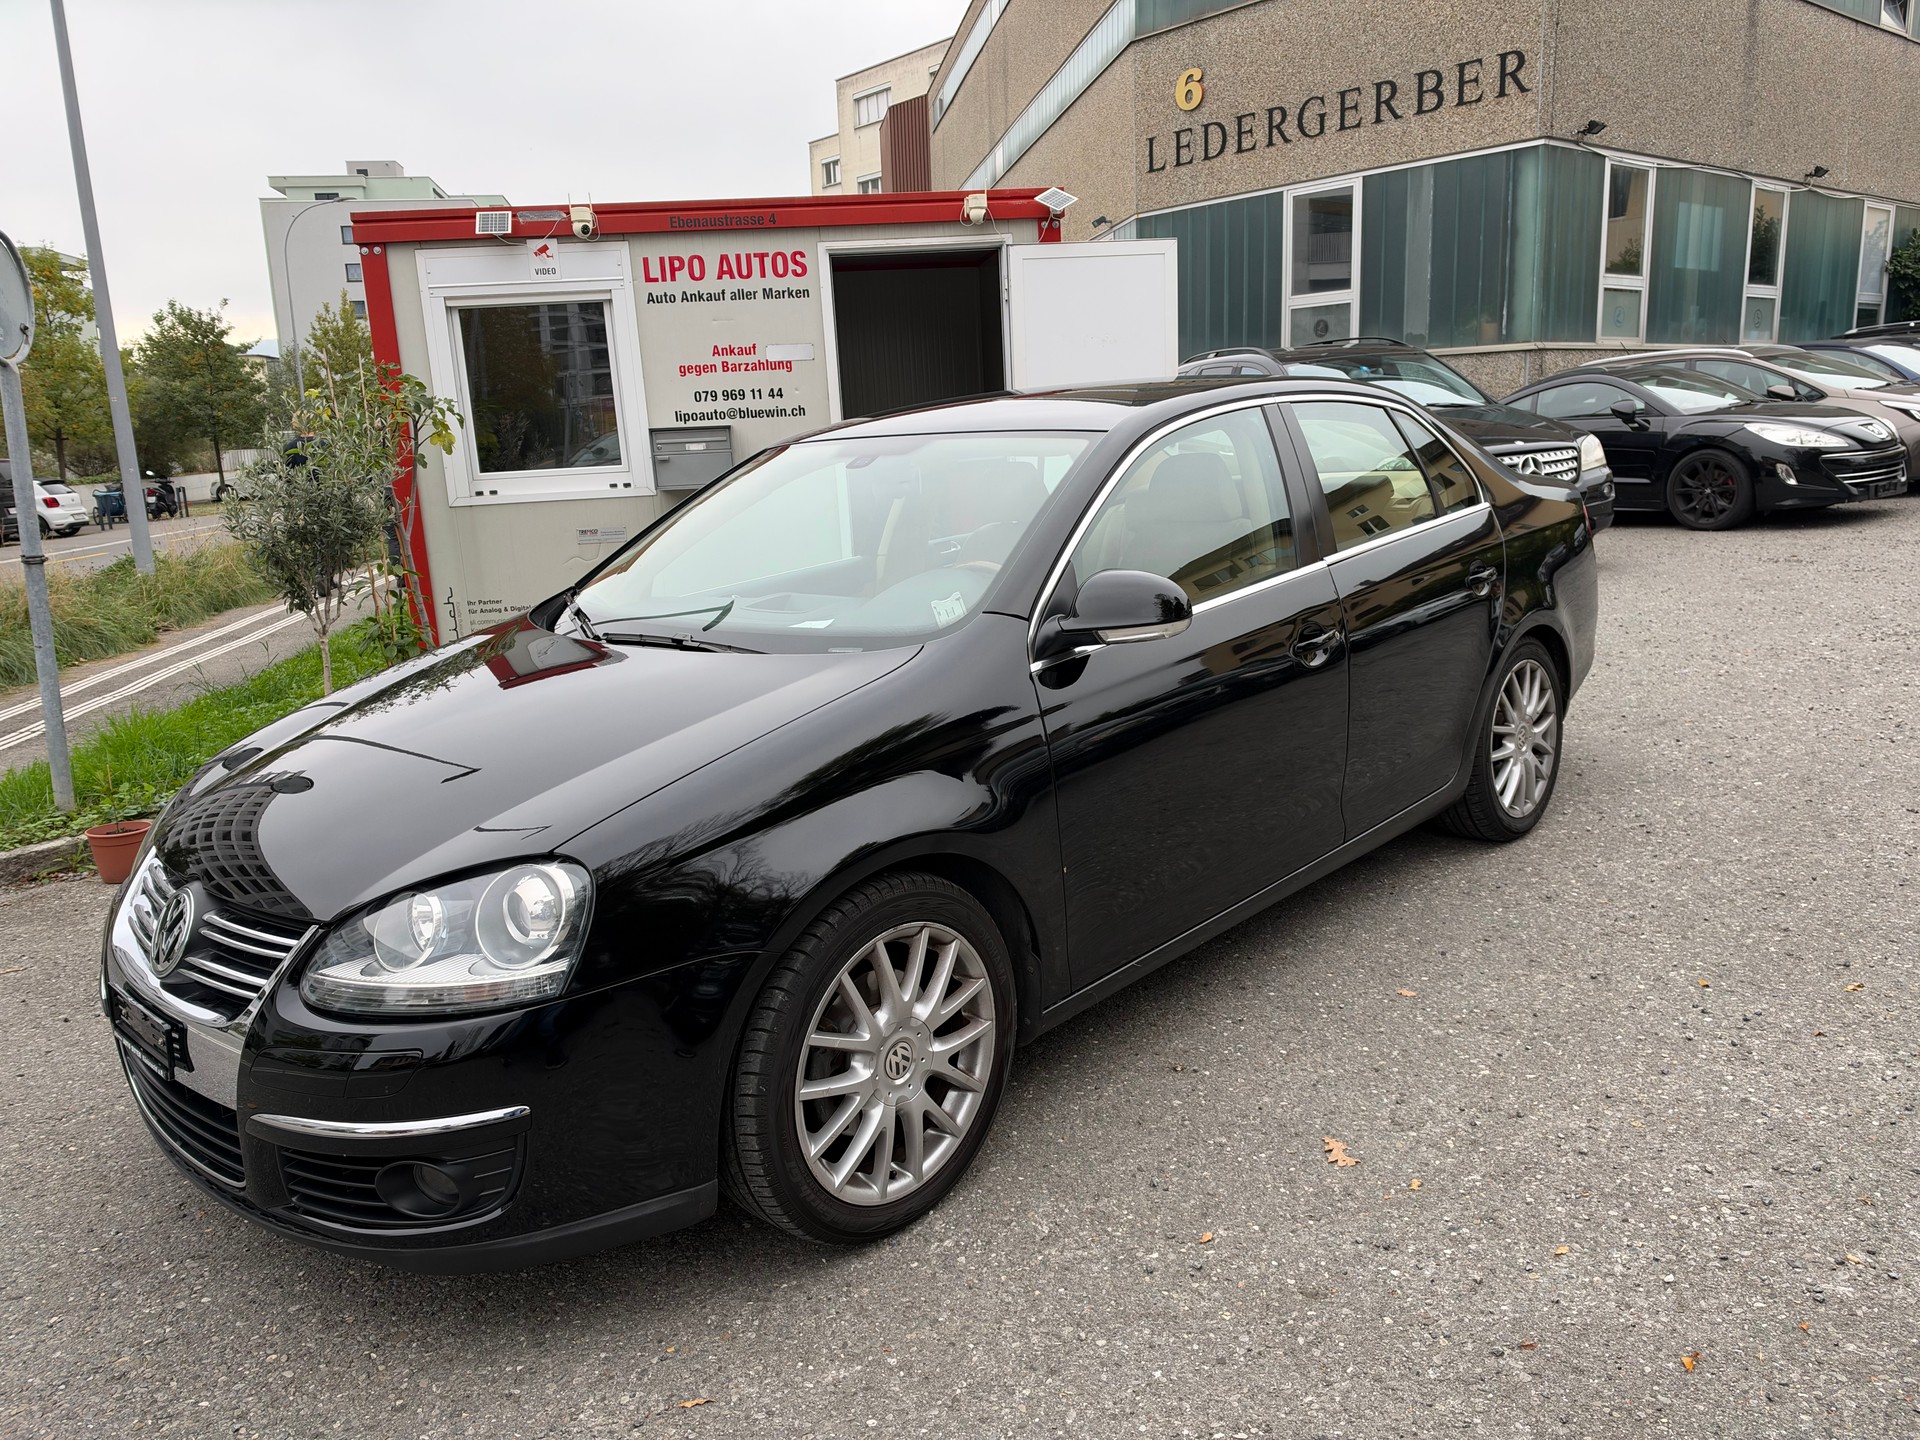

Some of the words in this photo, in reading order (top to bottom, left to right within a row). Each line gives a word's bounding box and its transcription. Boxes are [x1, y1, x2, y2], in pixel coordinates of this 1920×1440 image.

[1175, 67, 1204, 111] 6
[1146, 50, 1531, 173] LEDERGERBER
[669, 214, 765, 229] Ebenaustrasse
[768, 213, 777, 225] 4
[534, 267, 557, 276] VIDEO
[642, 254, 706, 283] LIPO
[716, 250, 808, 281] AUTOS
[647, 292, 676, 304] Auto
[681, 289, 726, 303] Ankauf
[730, 288, 758, 301] aller
[762, 286, 810, 300] Marken
[712, 343, 757, 357] Ankauf
[678, 362, 718, 377] gegen
[721, 359, 793, 374] Barzahlung
[694, 389, 718, 403] 079
[721, 388, 746, 402] 969
[750, 388, 763, 400] 11
[768, 387, 784, 399] 44
[674, 405, 806, 425] lipoauto@bluewin.ch
